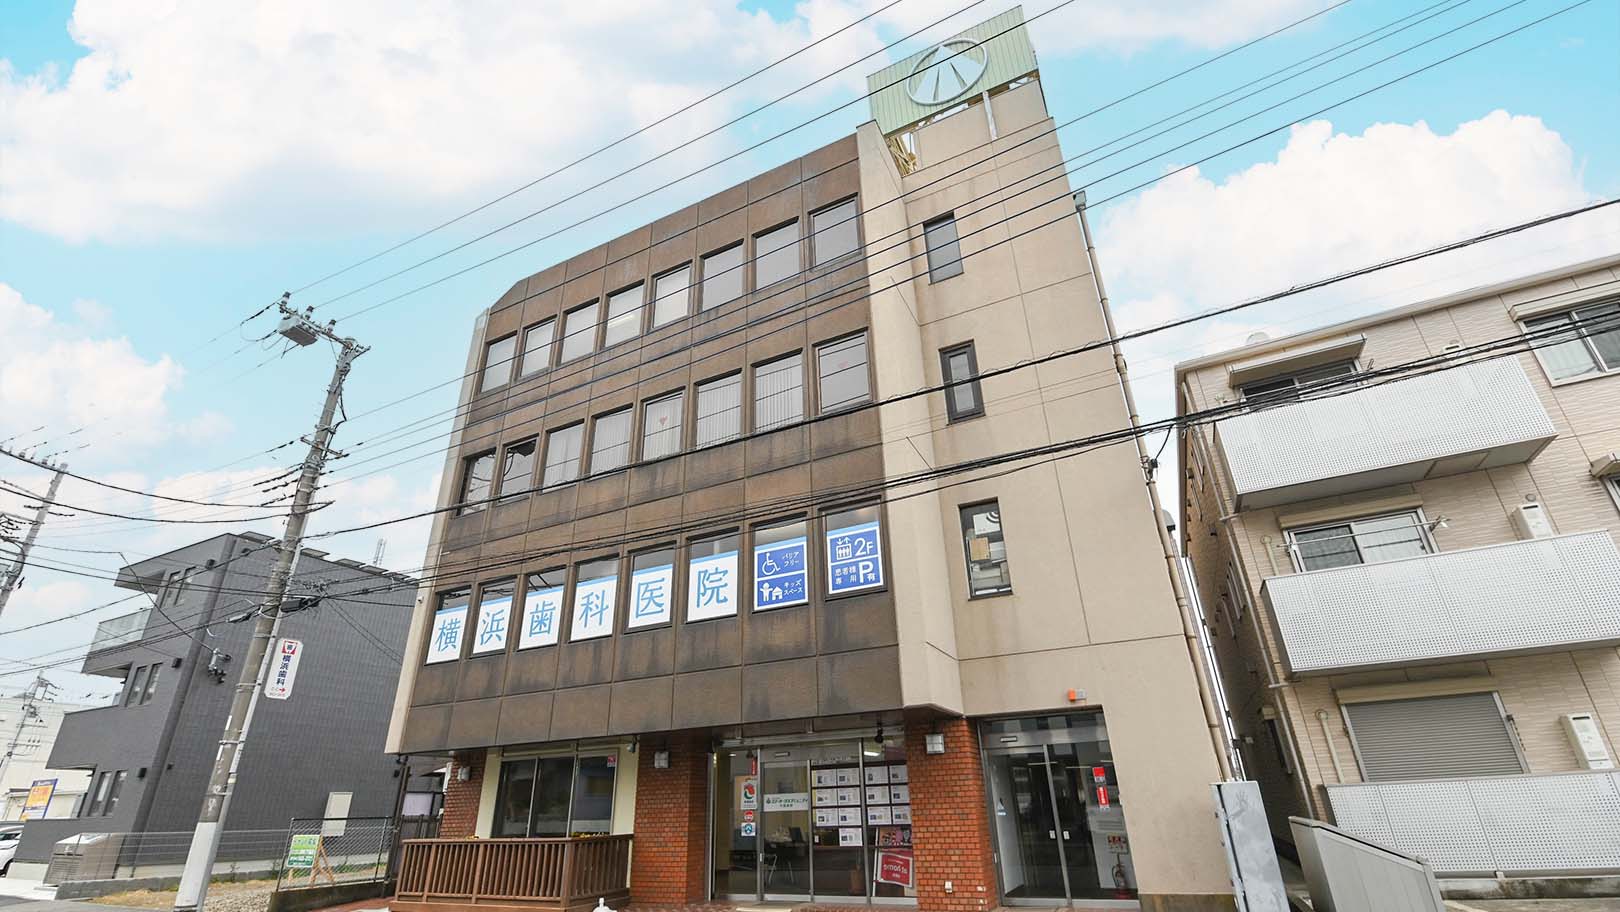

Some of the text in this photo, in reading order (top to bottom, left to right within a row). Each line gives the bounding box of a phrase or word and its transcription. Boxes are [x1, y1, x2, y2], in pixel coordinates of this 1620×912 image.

[854, 537, 873, 557] 2F
[434, 566, 729, 652] 横浜歯科医院
